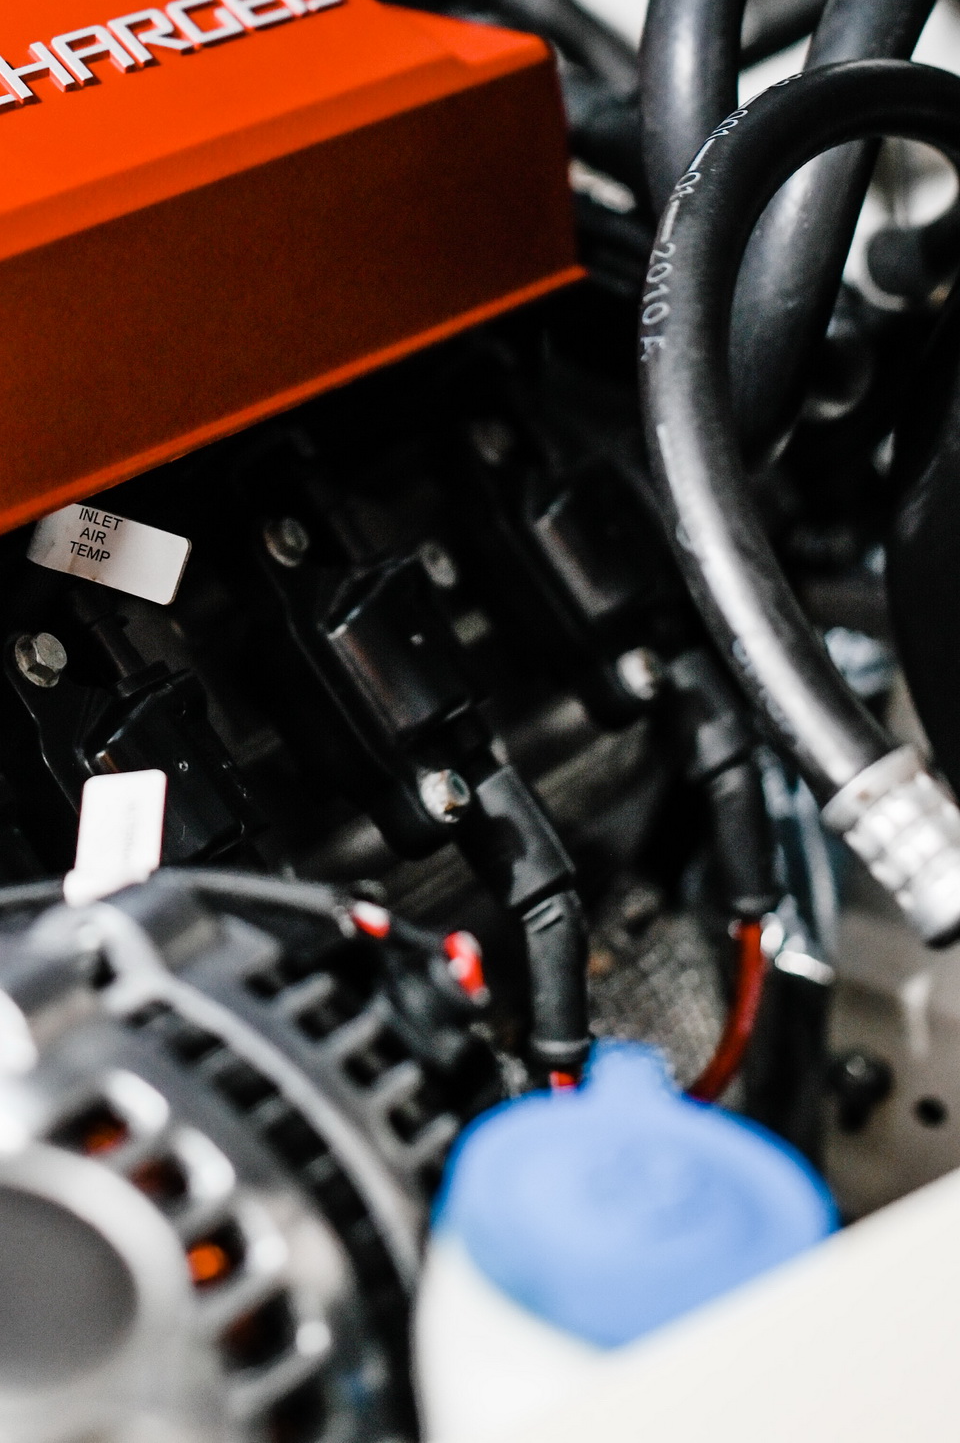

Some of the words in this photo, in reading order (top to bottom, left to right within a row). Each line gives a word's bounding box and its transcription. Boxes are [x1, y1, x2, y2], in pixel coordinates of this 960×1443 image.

[78, 508, 123, 530] INLET
[79, 527, 106, 545] AIR
[70, 540, 111, 562] TEMP
